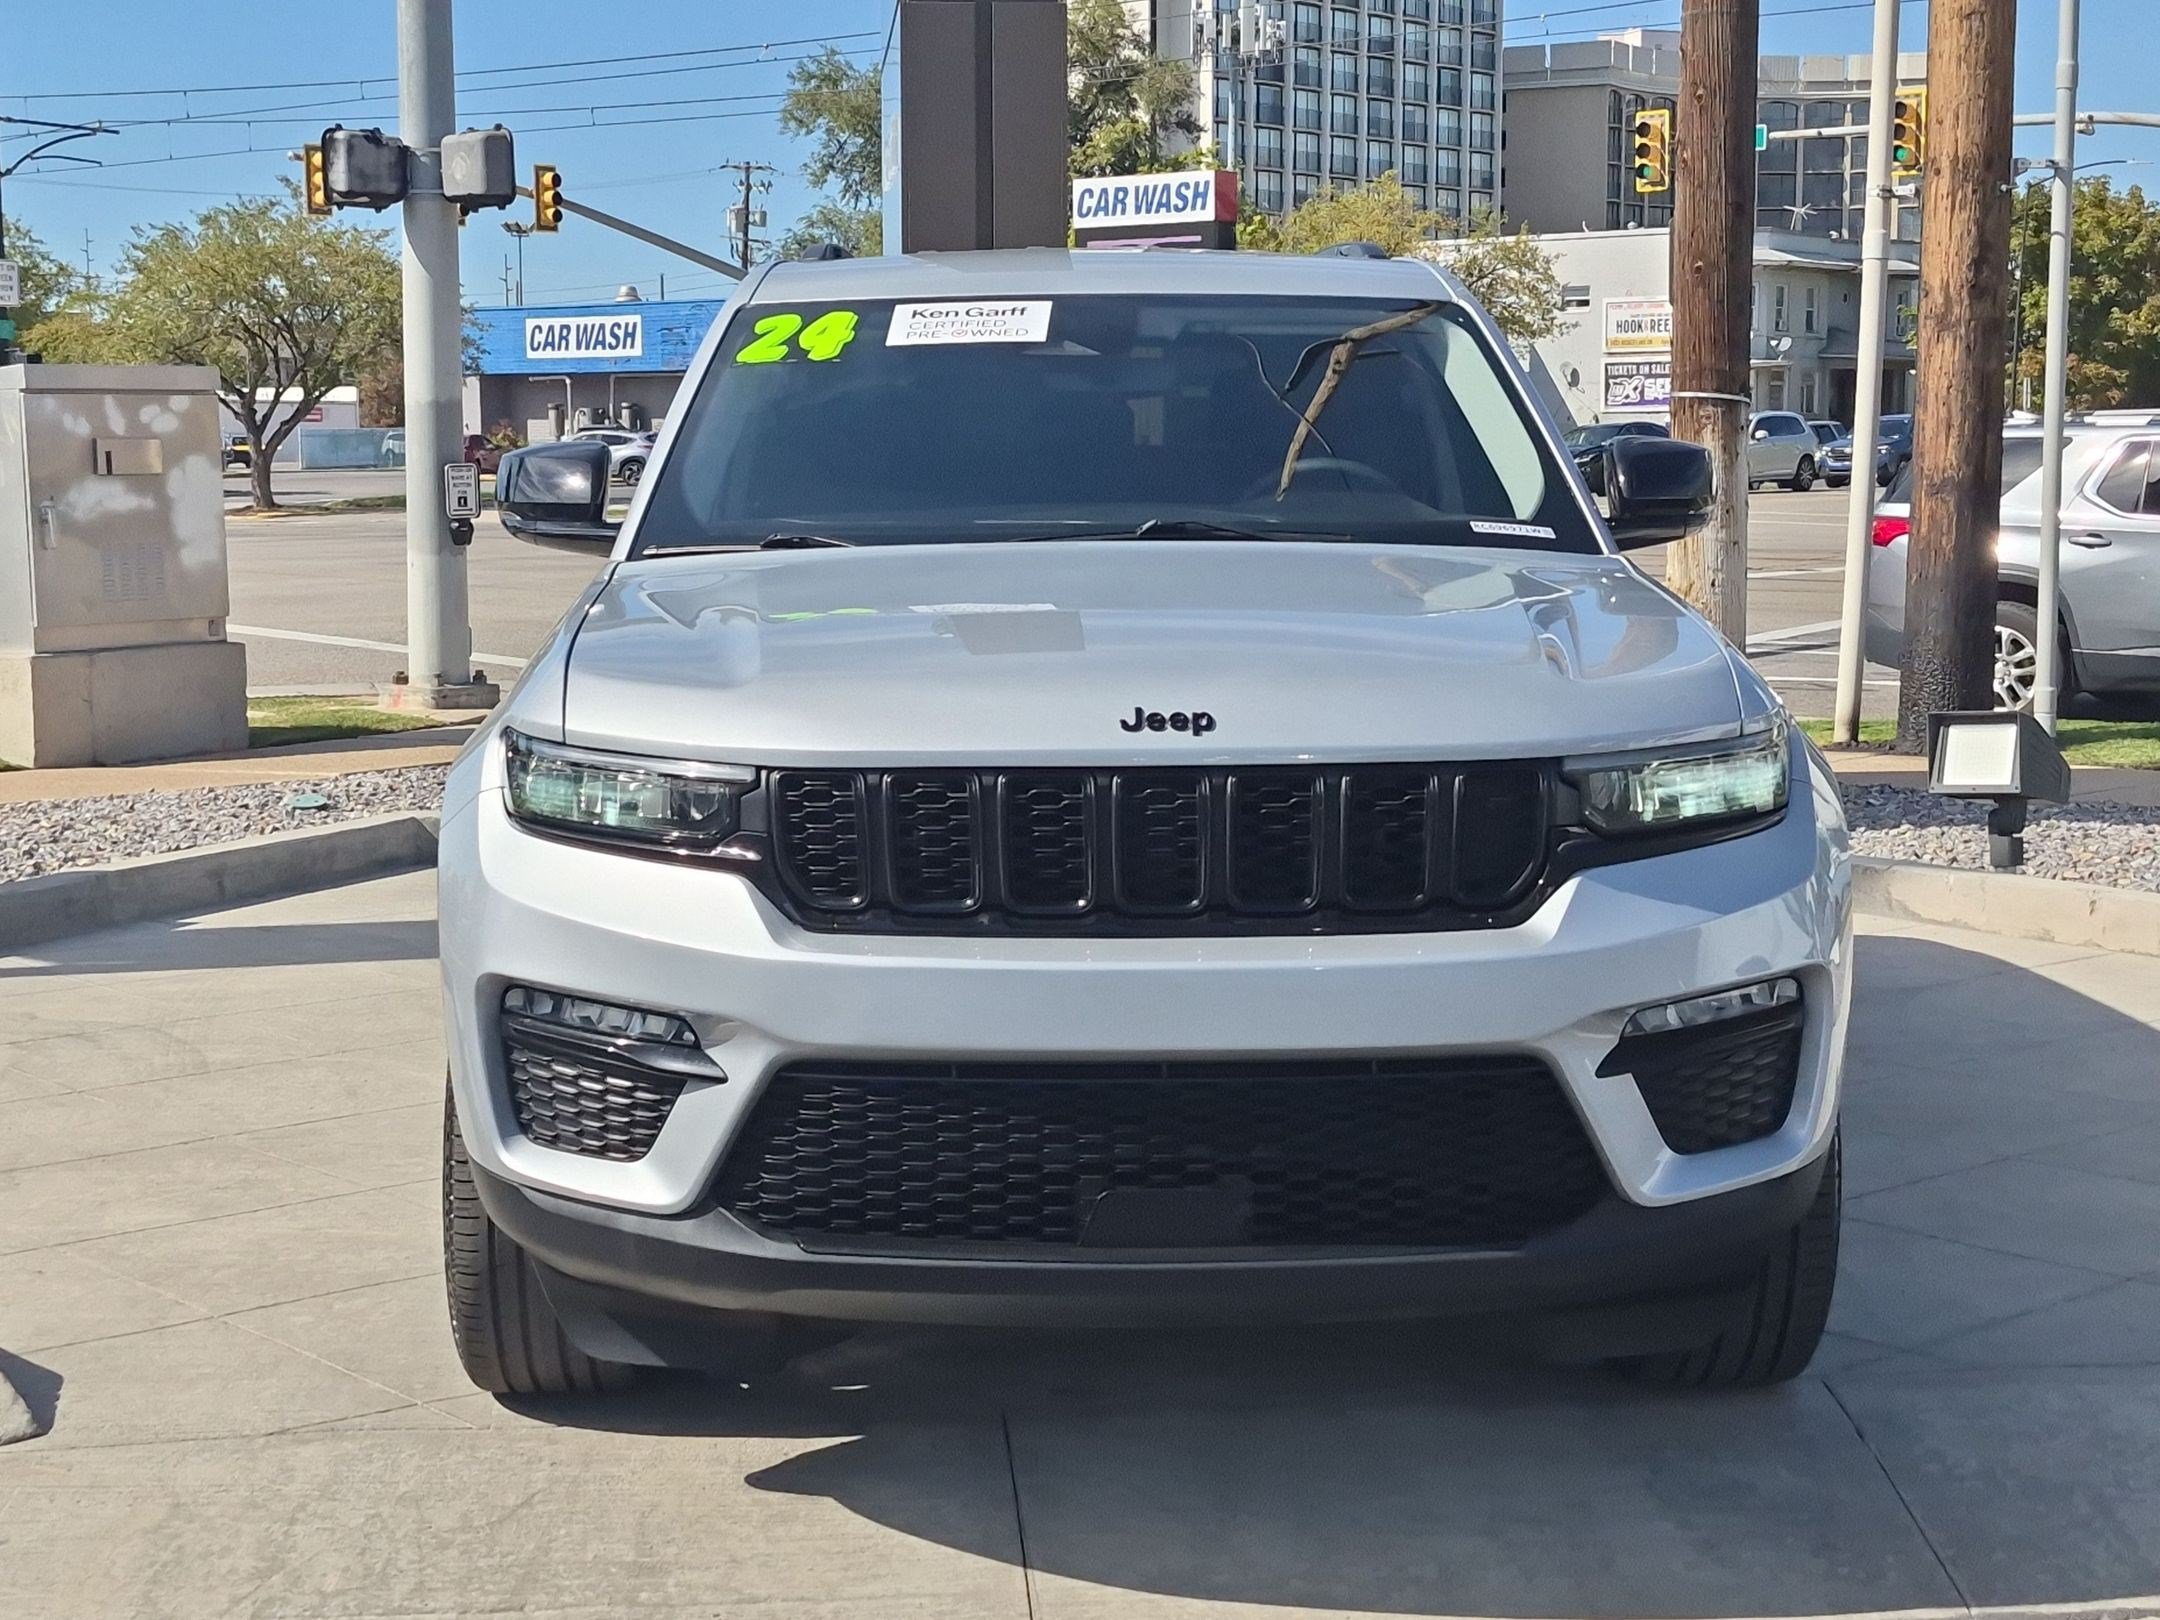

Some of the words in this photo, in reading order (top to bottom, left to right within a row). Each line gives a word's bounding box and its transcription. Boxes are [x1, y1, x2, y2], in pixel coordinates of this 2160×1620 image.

[1077, 186, 1129, 218] CAR
[1134, 180, 1211, 215] WASH
[911, 308, 960, 319] Ken
[965, 306, 1028, 318] Garff
[908, 319, 1007, 331] CERTIFIED
[1616, 319, 1644, 333] HOOK
[529, 324, 572, 352] CAR
[575, 321, 638, 351] WASH
[736, 310, 859, 364] 24
[1607, 364, 1637, 376] TICKETS
[1119, 706, 1217, 737] Jeep
